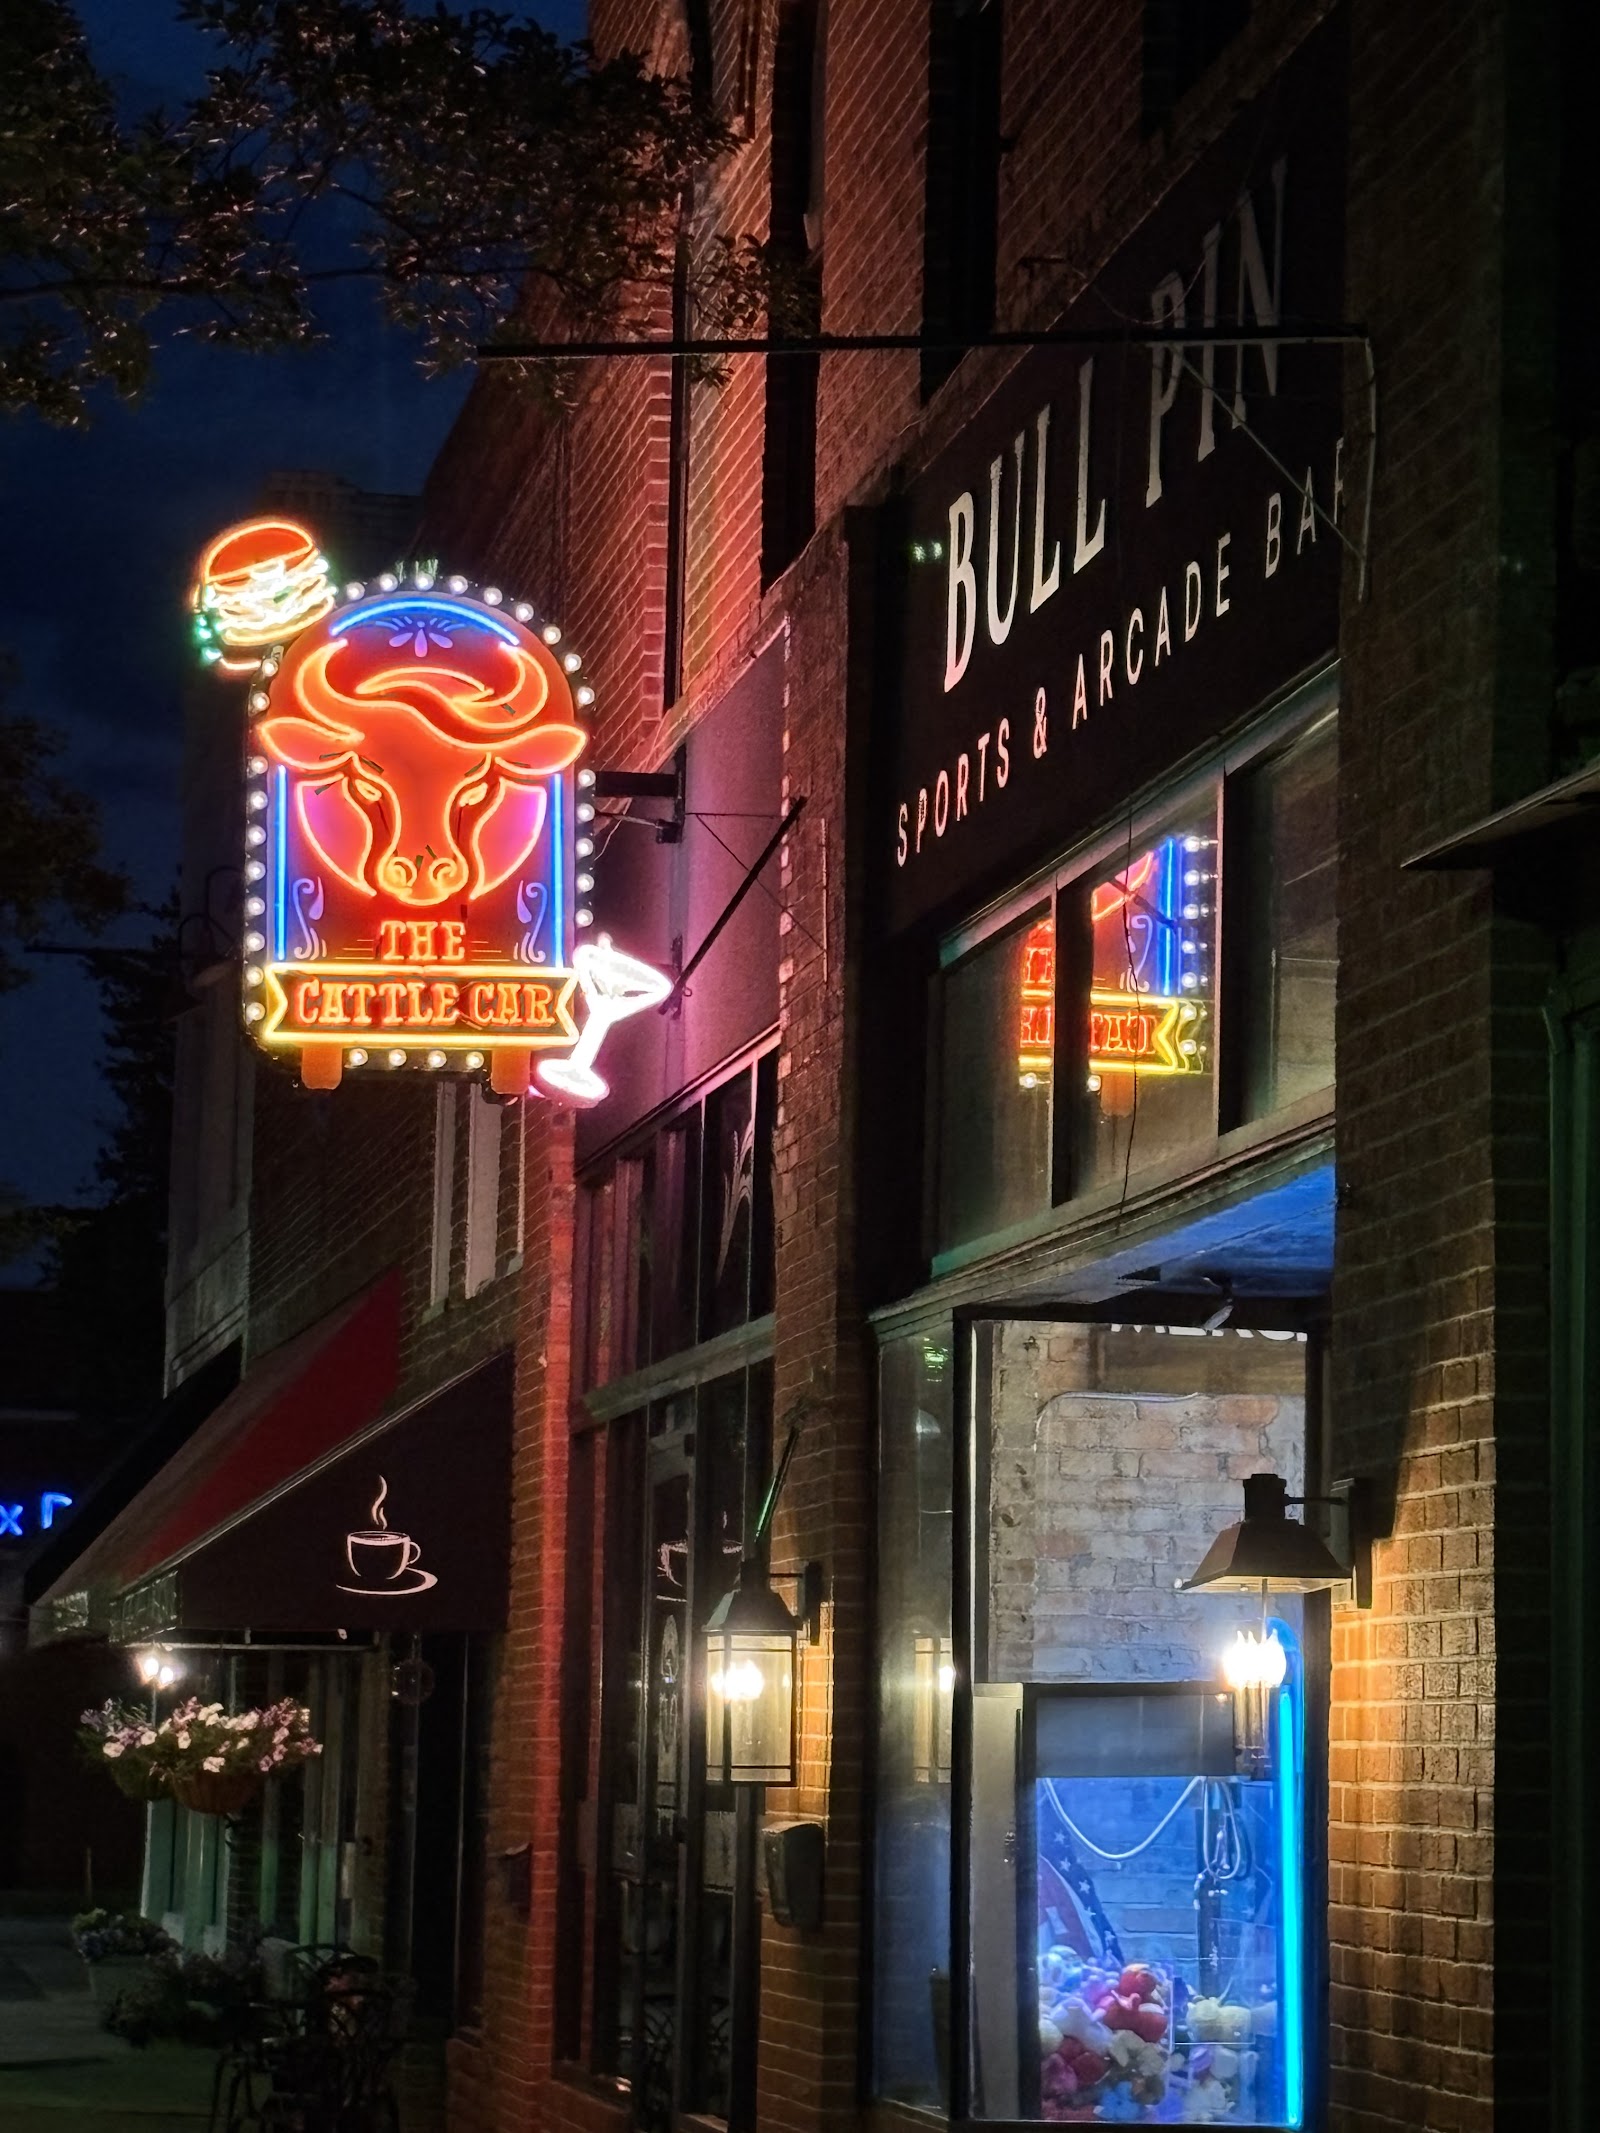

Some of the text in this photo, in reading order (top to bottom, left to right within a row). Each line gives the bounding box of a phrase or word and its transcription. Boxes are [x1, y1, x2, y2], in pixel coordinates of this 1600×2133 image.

[943, 154, 1288, 693] BULL PIN
[897, 718, 1010, 868] SPORTS
[1032, 687, 1049, 759] &
[1072, 532, 1231, 730] ARCADE
[297, 978, 556, 1026] CATTLE CAR
[381, 920, 466, 961] THE
